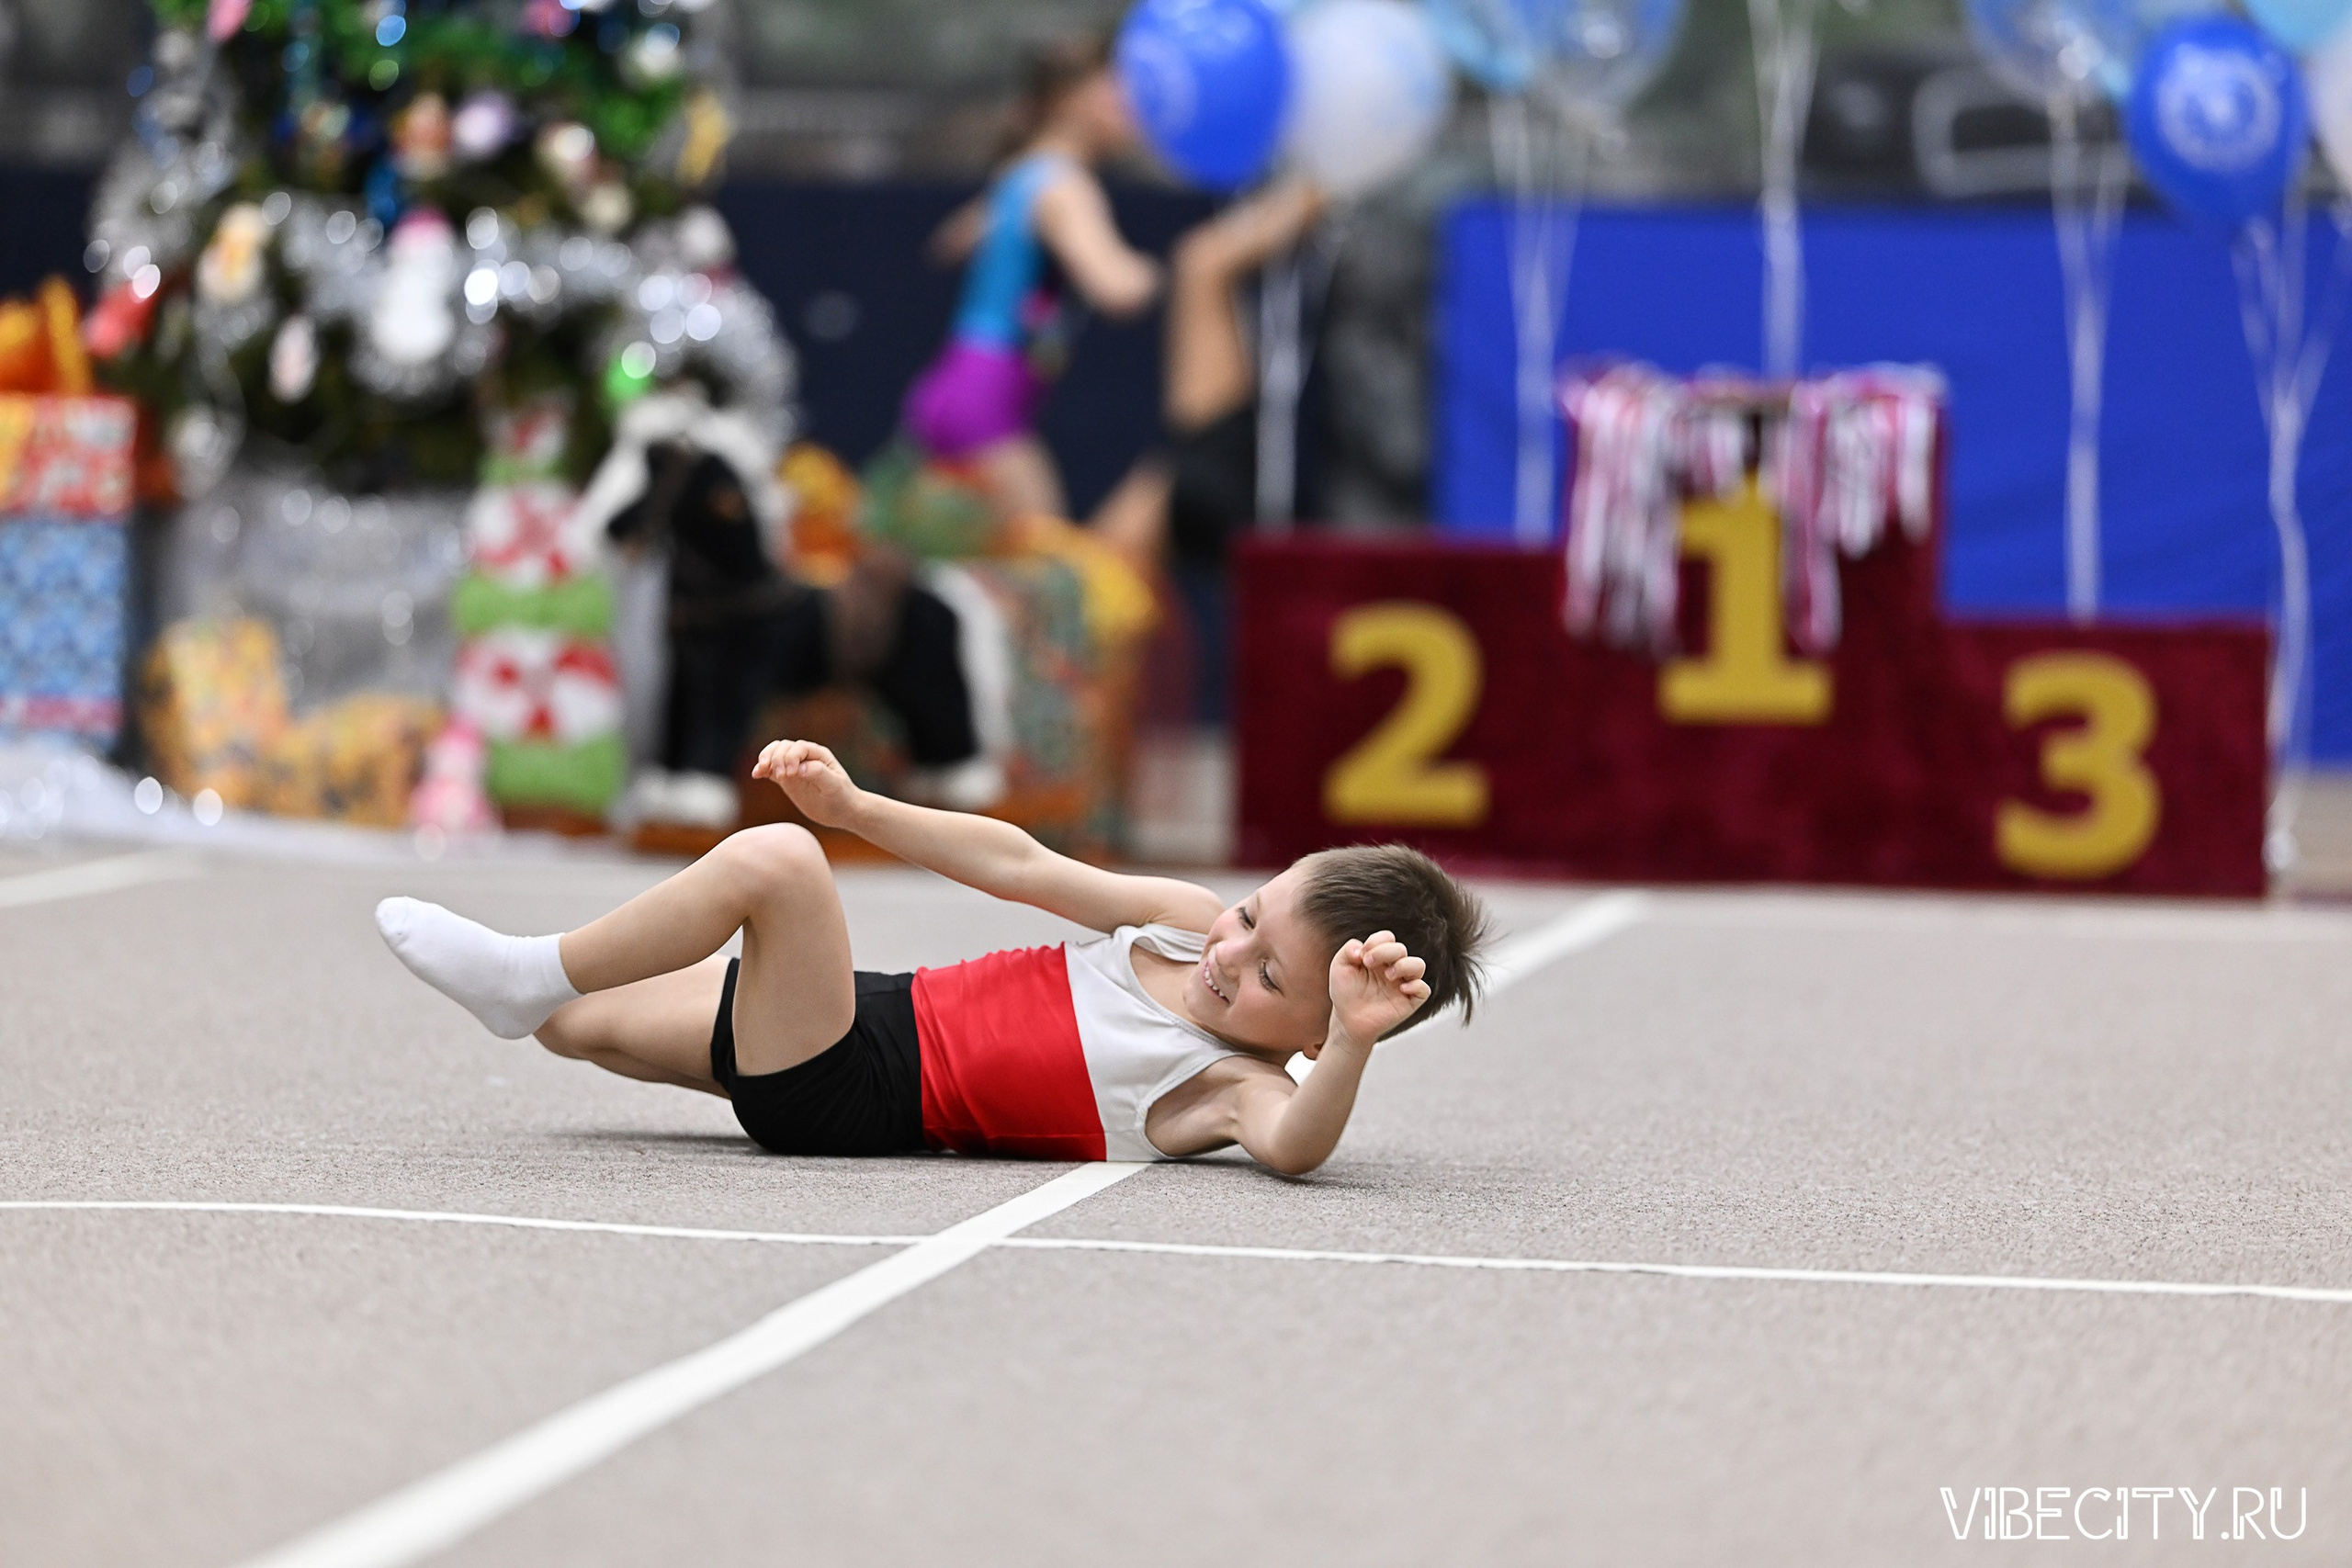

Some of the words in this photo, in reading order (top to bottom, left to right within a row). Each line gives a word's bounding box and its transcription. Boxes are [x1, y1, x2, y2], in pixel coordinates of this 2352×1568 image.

[1658, 470, 1833, 723] 1
[1325, 604, 1487, 822] 2
[1996, 654, 2160, 875] 3
